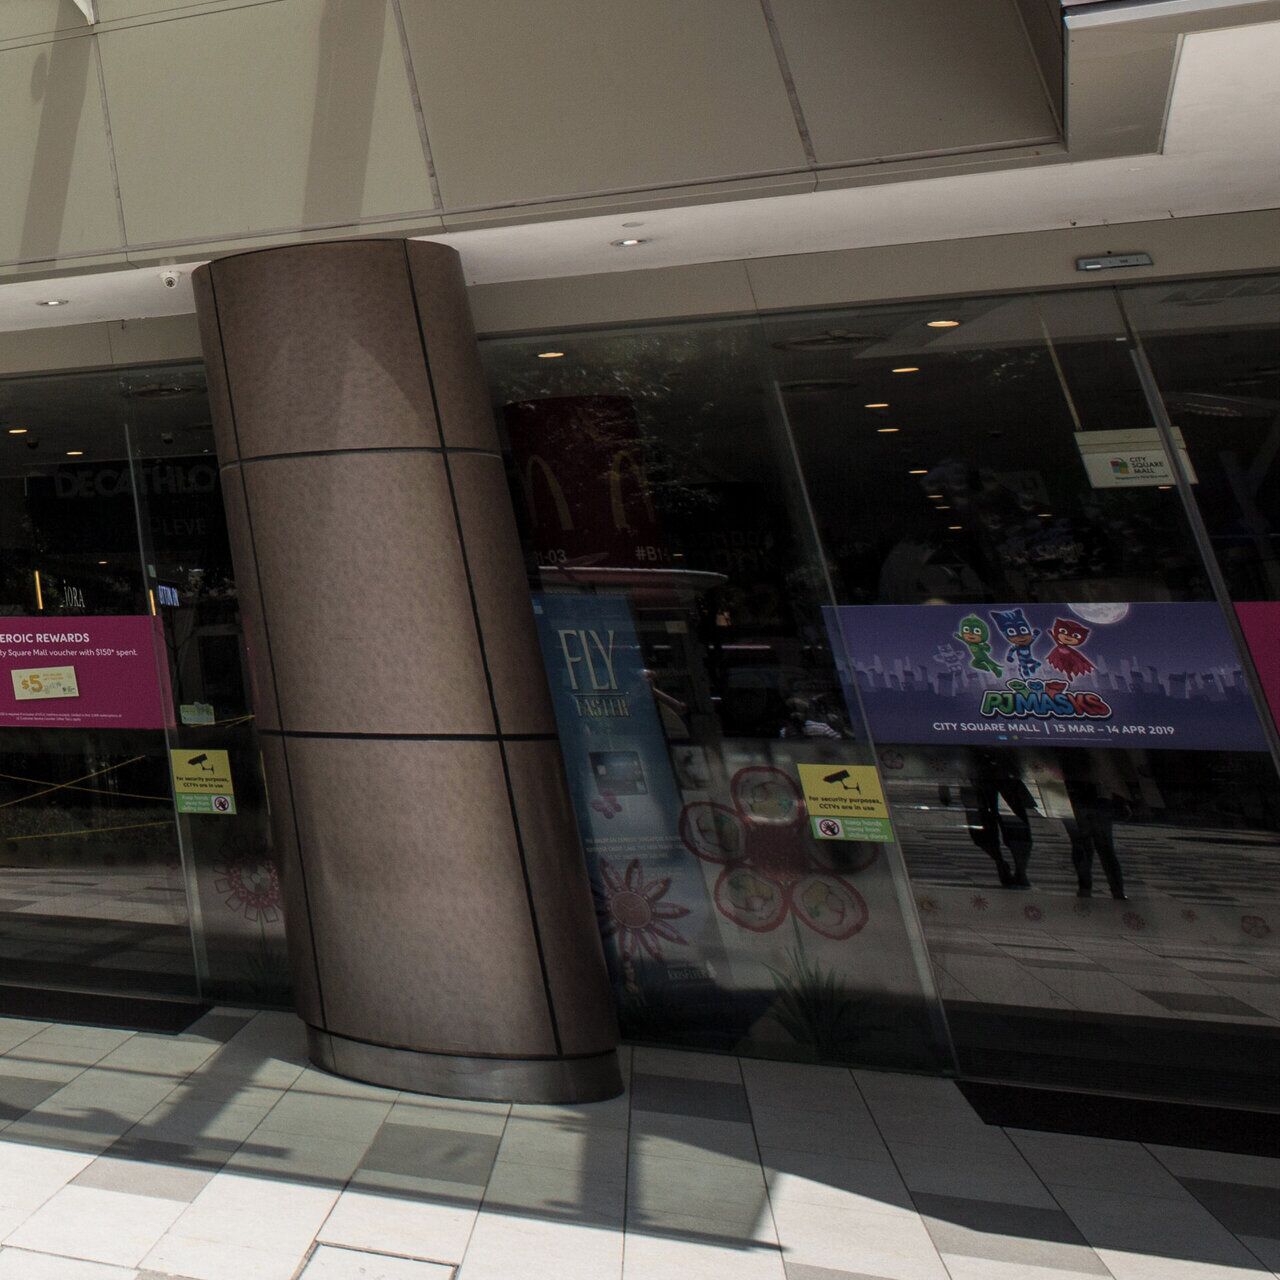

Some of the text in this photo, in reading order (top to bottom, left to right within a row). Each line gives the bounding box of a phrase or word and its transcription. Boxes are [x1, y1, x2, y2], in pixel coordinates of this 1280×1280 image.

[54, 463, 217, 499] DECATHLO
[35, 632, 90, 643] REWARDS
[7, 648, 32, 658] Square
[33, 648, 48, 657] Mall
[49, 648, 77, 657] voucher
[78, 648, 95, 656] with
[115, 649, 138, 659] spent.
[558, 629, 619, 691] FLY
[933, 722, 958, 732] CITY
[960, 722, 1005, 732] SQUARE
[1008, 723, 1041, 733] MALL
[1053, 724, 1066, 733] 15
[1068, 724, 1095, 734] MAR
[1105, 725, 1119, 735] 14
[1122, 725, 1146, 735] APR
[1148, 725, 1175, 735] 2019
